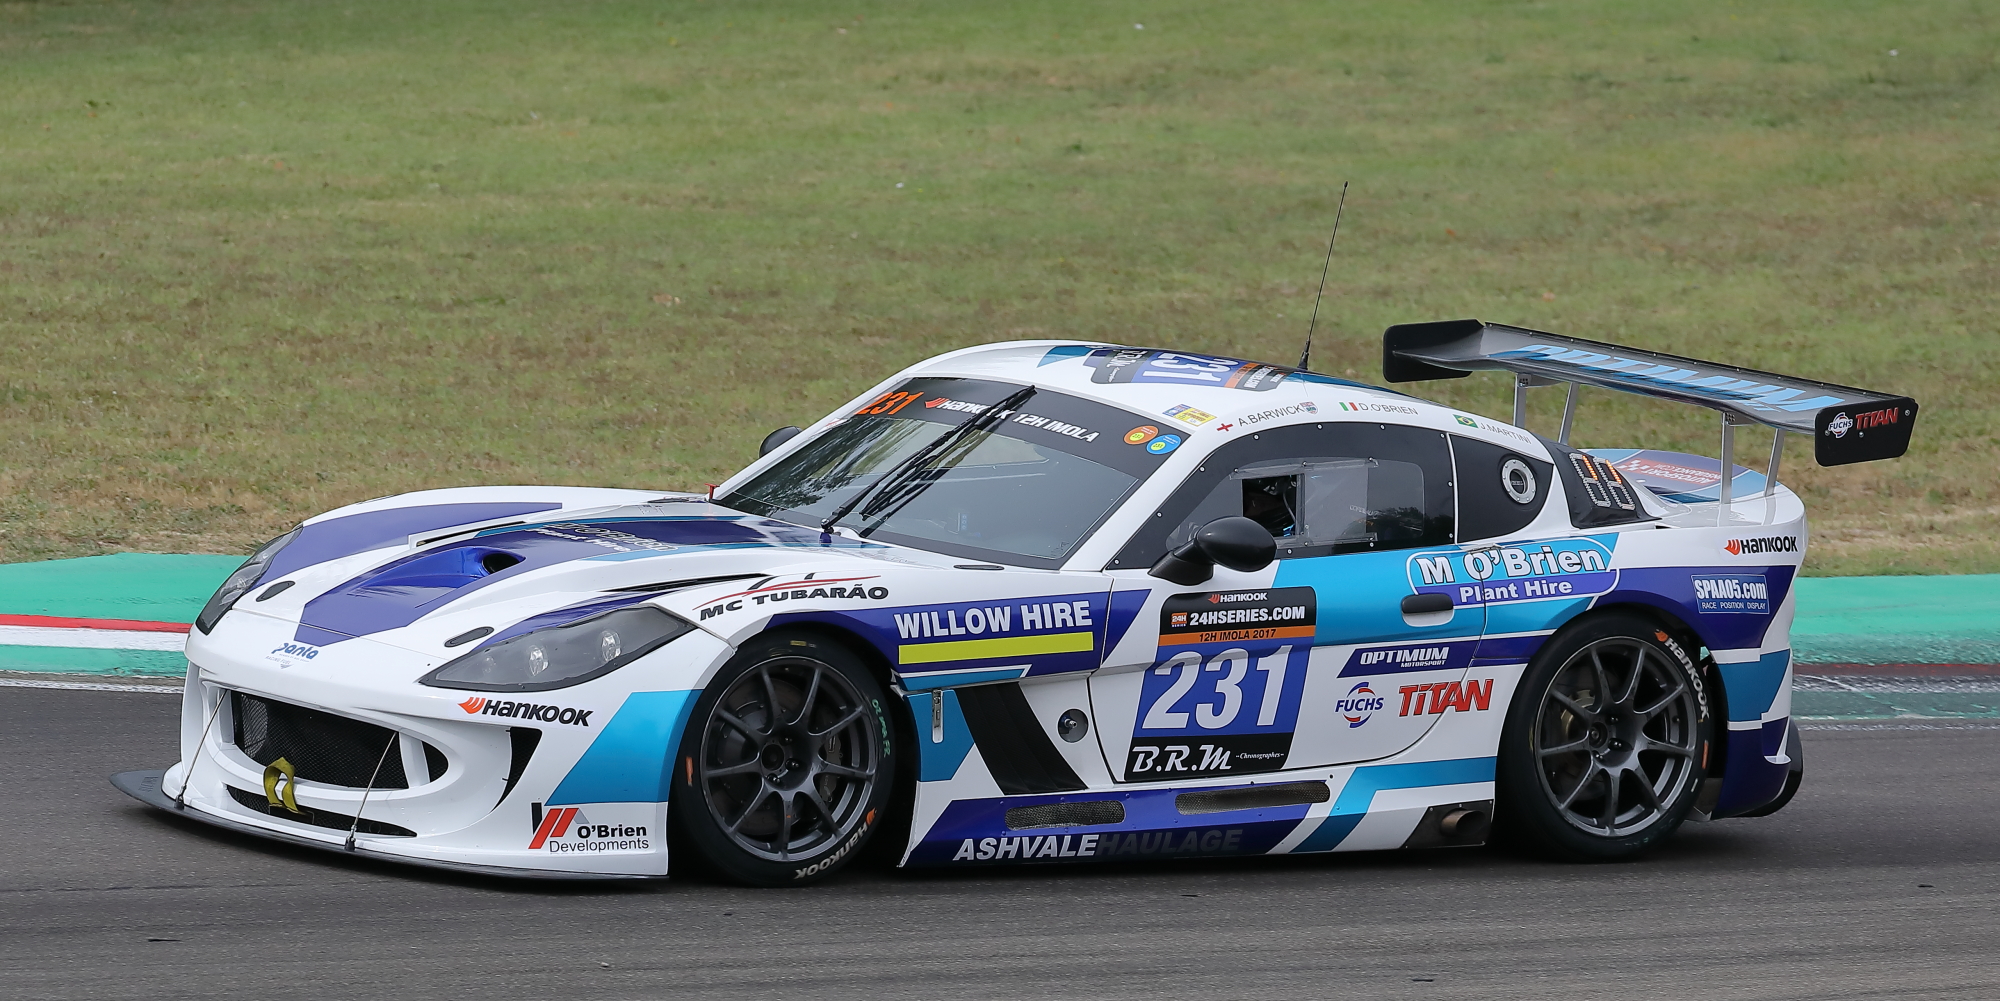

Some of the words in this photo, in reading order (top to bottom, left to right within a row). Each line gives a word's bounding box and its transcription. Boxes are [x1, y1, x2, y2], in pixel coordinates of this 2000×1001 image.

[1143, 352, 1239, 382] 231
[854, 391, 924, 416] 231
[1358, 402, 1419, 416] D.O'BRIEN
[1238, 403, 1305, 427] A.BARWICK
[1828, 418, 1854, 431] FUCHS
[1012, 413, 1046, 430] 12H
[1044, 418, 1100, 443] IMOLA
[1480, 422, 1532, 445] J.MARTINI
[1415, 556, 1455, 585] M
[1463, 545, 1607, 581] O'Brien
[1459, 582, 1519, 603] Plant
[1524, 579, 1573, 597] Hire
[1694, 579, 1767, 600] SPAA05.com
[700, 600, 743, 621] MC
[752, 583, 889, 605] TUBARÃO
[1720, 601, 1744, 609] POSITION
[1747, 602, 1766, 610] DISPLAY
[894, 606, 1011, 639] WILLOW
[1020, 600, 1093, 630] HIRE
[1190, 606, 1306, 626] 24HSERIES.COM
[1199, 632, 1217, 642] 12H
[1219, 630, 1250, 641] IMOLA
[1252, 629, 1276, 639] 2017
[1360, 646, 1449, 665] OPTIMUM
[1400, 660, 1446, 668] MOTORSPORT
[1142, 645, 1294, 730] 231
[1334, 697, 1384, 713] FUCHS
[577, 824, 648, 840] O'Brien
[550, 838, 650, 853] Developments
[953, 834, 1099, 861] ASHVALE
